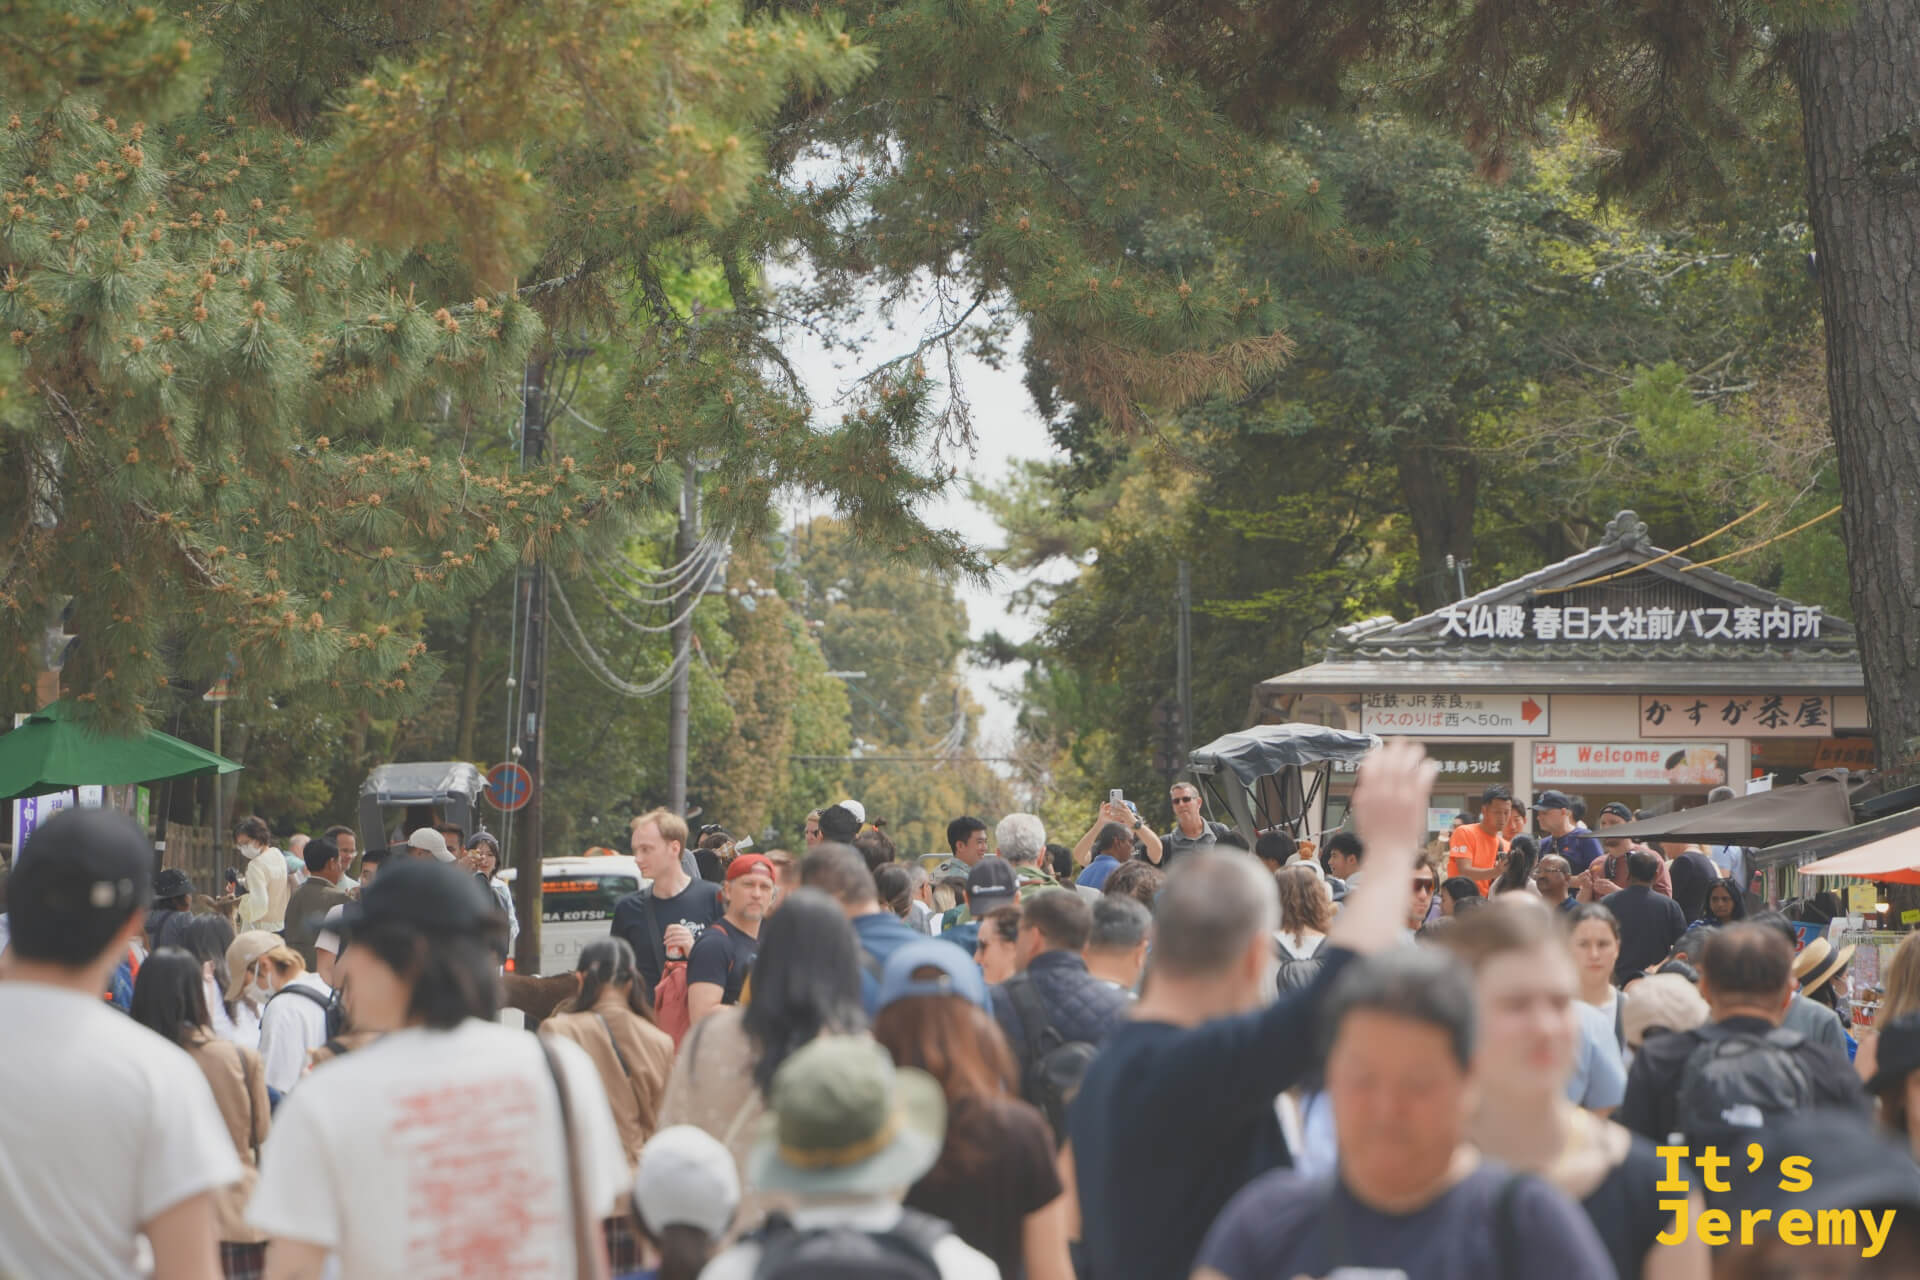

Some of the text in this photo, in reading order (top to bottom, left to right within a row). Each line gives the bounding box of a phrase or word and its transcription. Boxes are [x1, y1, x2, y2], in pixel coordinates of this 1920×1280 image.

[1439, 604, 1823, 640] 大仏殿 春日大社前バス案内所
[1645, 695, 1830, 729] かすが茶屋
[1577, 745, 1661, 763] Welcome
[563, 910, 606, 920] KOTSU
